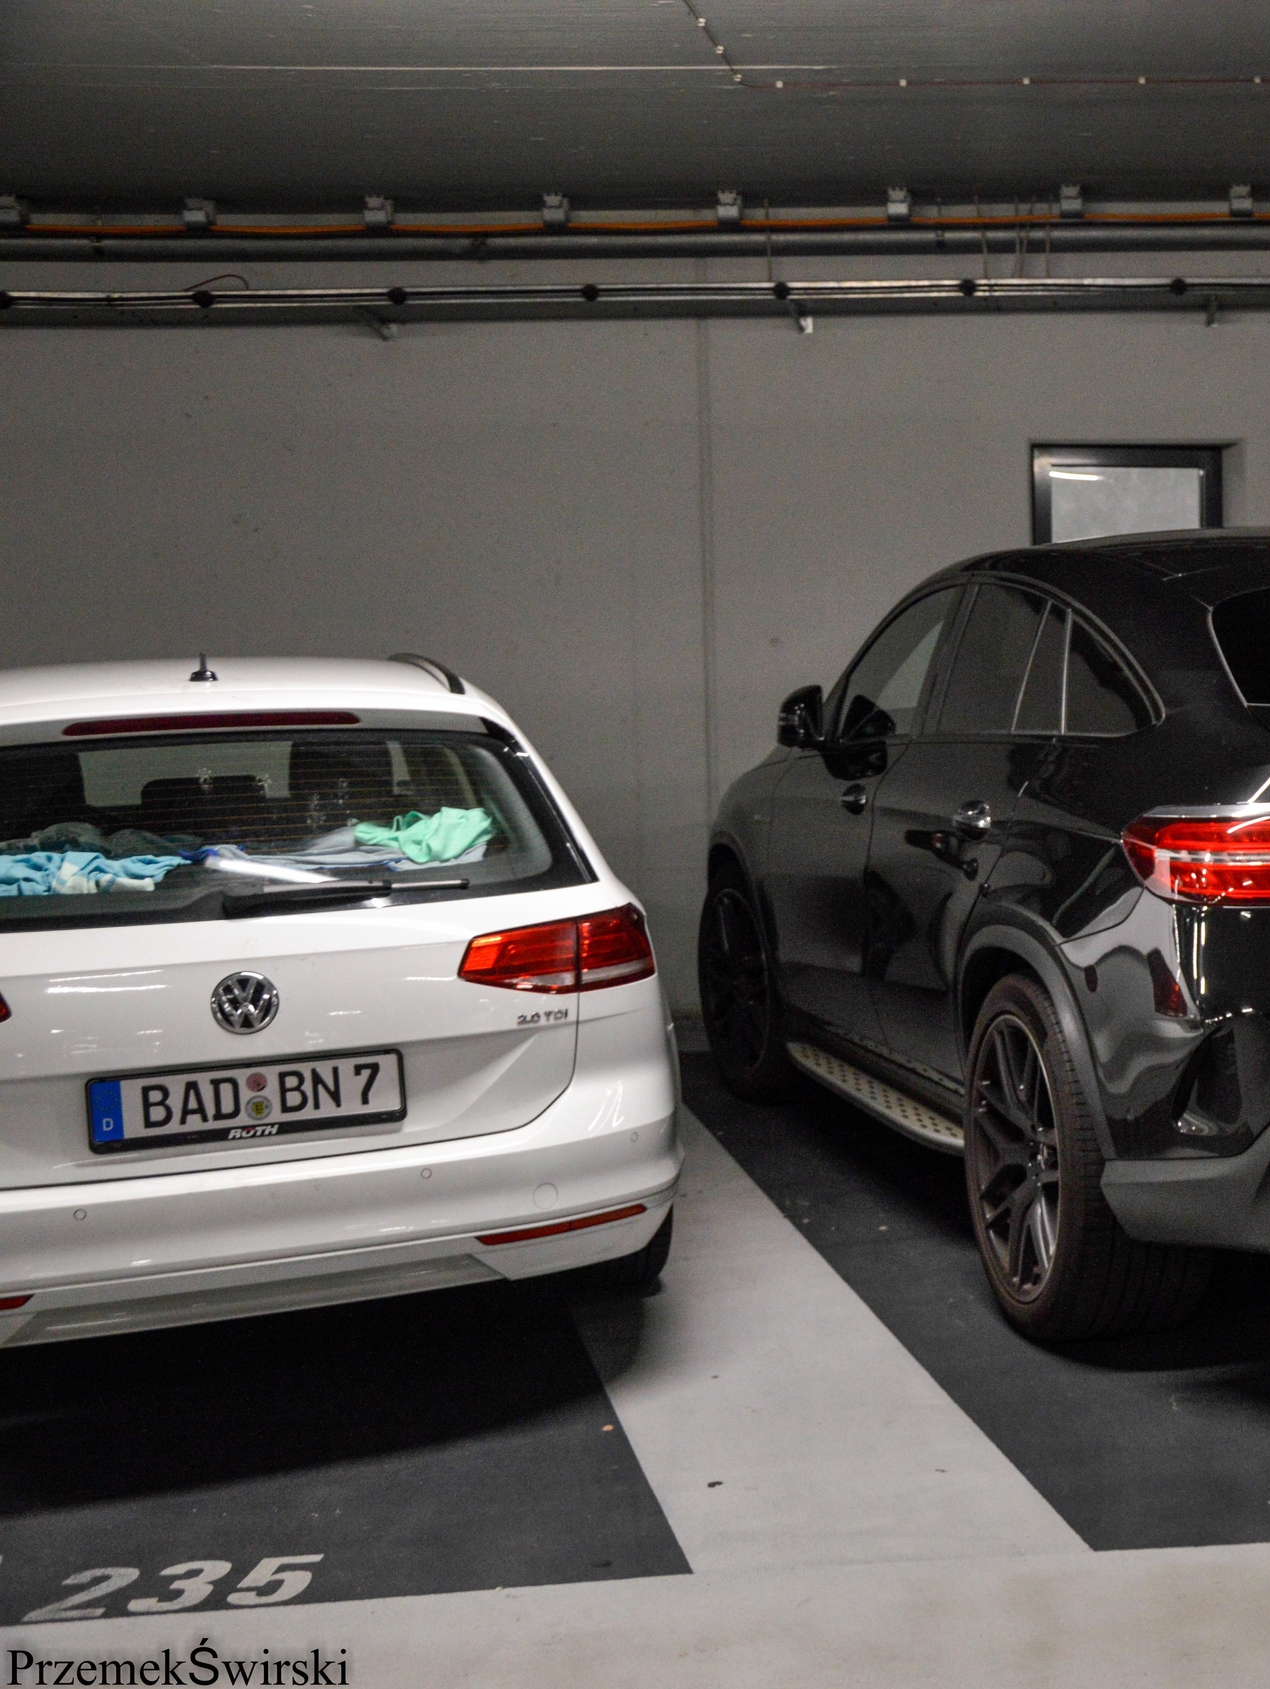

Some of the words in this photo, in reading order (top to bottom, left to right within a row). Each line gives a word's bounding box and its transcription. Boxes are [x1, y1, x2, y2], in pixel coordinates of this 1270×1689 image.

[544, 1008, 568, 1021] TDI
[141, 1076, 242, 1129] BAD
[278, 1065, 342, 1114] BN
[354, 1061, 381, 1105] 7
[102, 1118, 114, 1132] D
[228, 1124, 280, 1140] ROTH
[20, 1553, 325, 1623] 235
